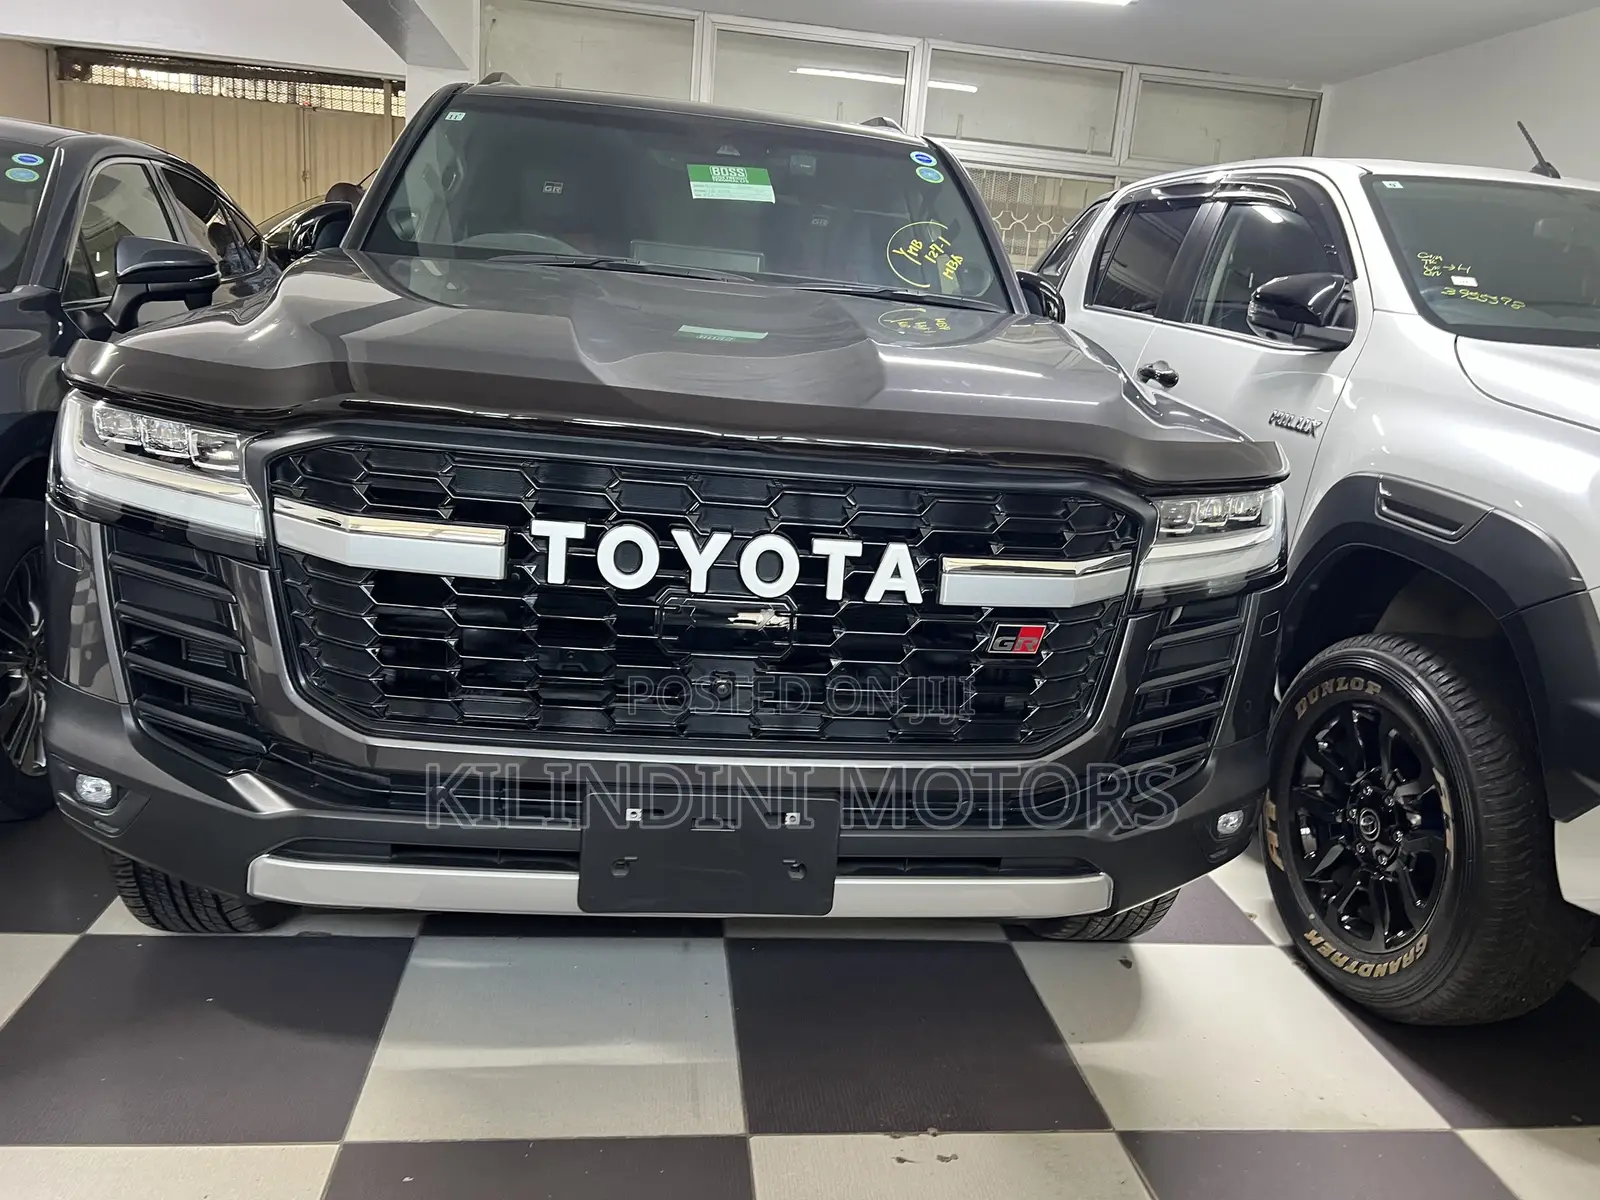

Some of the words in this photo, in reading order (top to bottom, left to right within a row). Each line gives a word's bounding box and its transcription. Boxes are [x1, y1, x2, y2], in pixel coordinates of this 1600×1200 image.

[712, 167, 746, 177] BOSS
[544, 185, 562, 193] GR
[531, 519, 924, 604] TOYOTA
[992, 636, 1039, 652] GR
[1295, 677, 1381, 719] DUNLOP
[1303, 928, 1429, 979] GRANDTREK
